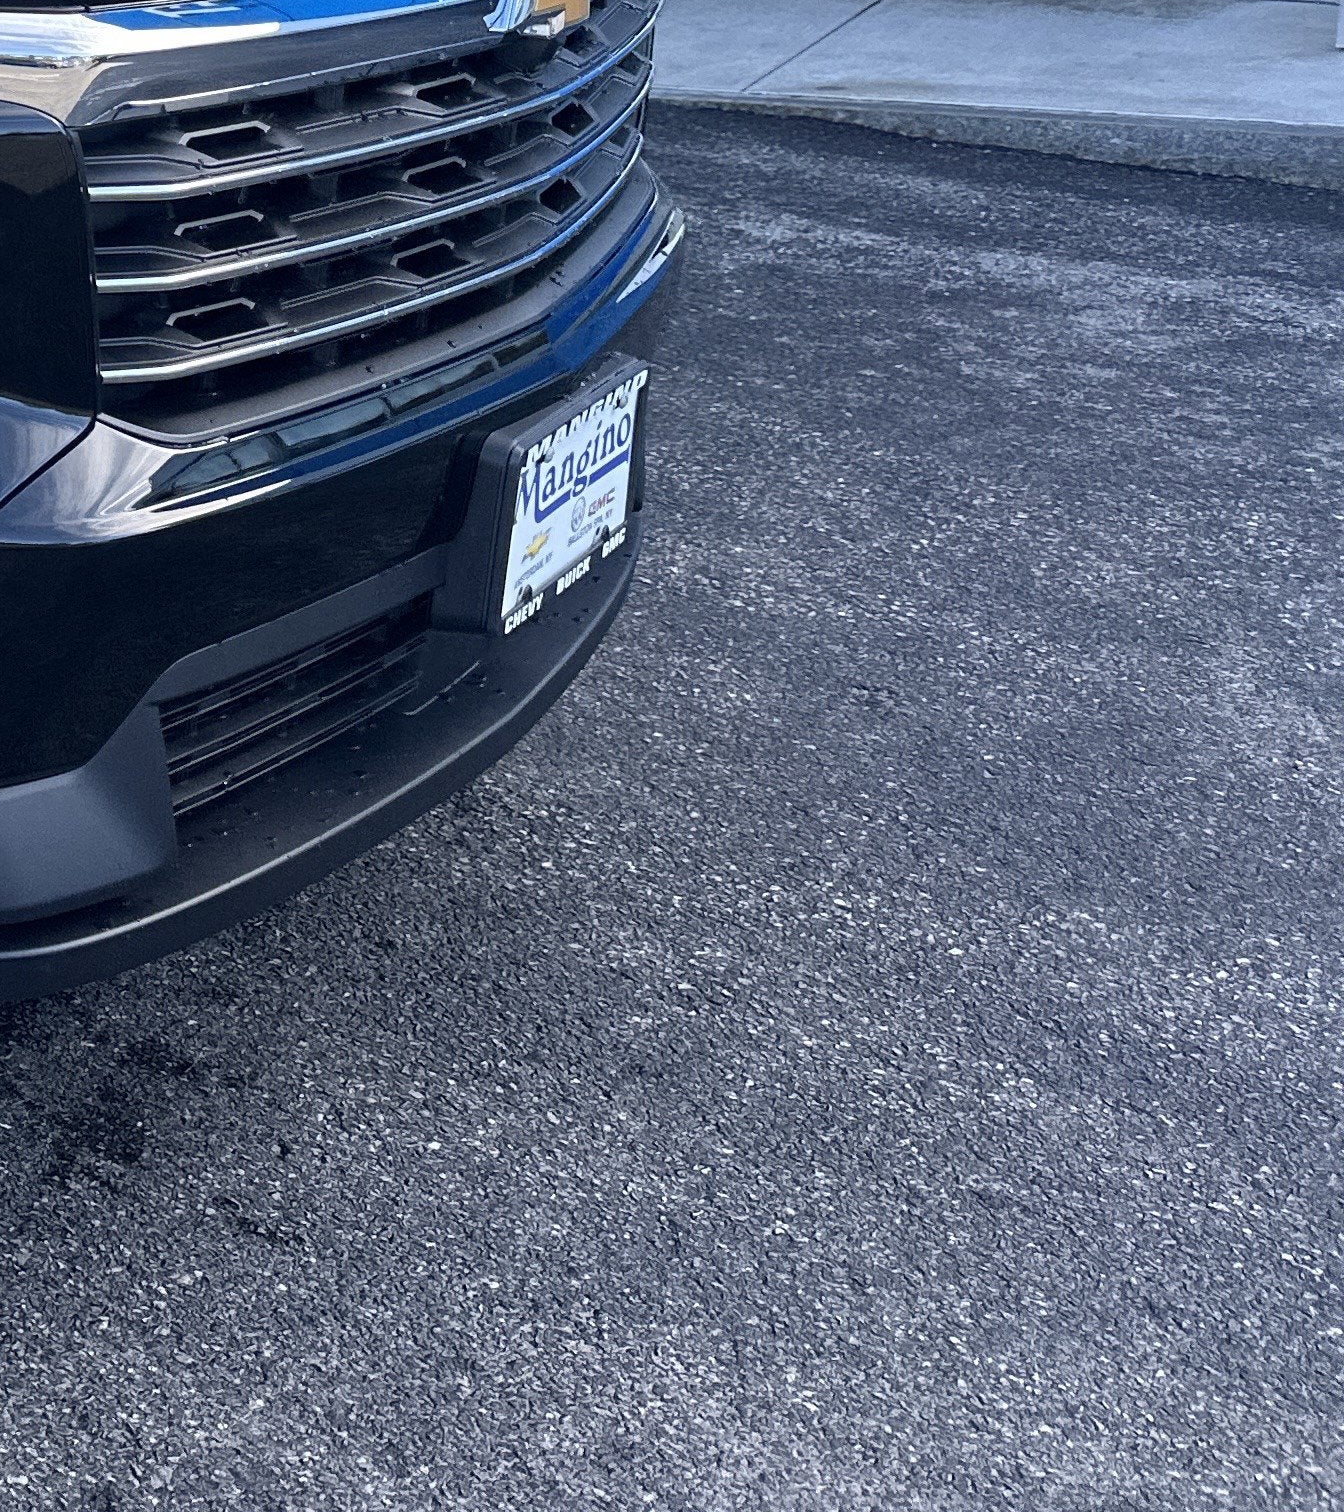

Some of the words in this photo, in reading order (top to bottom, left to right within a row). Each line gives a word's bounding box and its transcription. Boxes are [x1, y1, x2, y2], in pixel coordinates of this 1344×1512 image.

[515, 412, 632, 524] Mangino
[504, 592, 544, 635] CHEVY
[556, 556, 591, 595] BUICK
[602, 527, 627, 558] GMC
